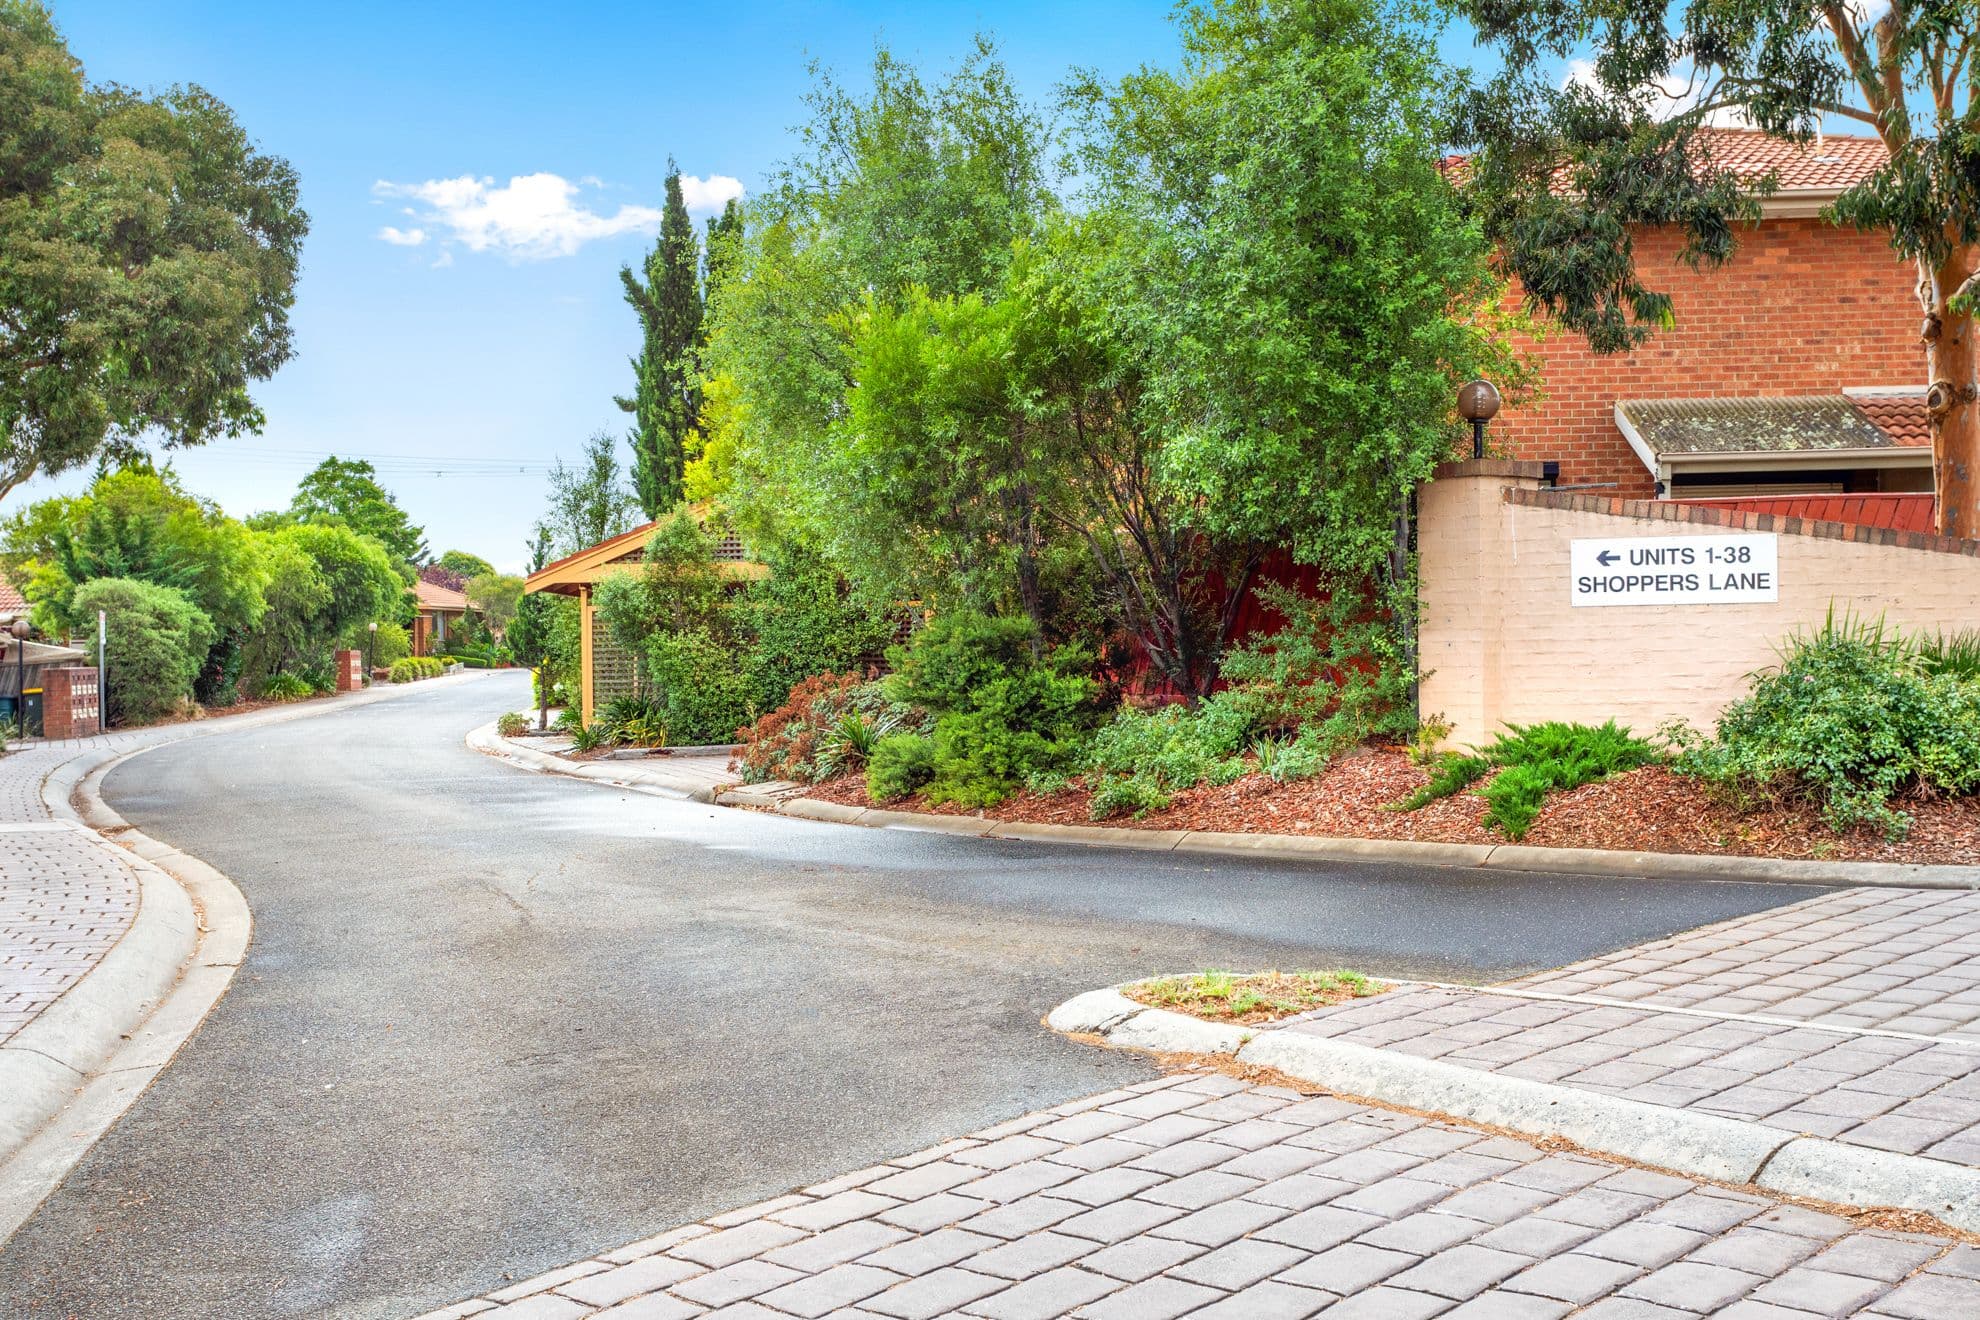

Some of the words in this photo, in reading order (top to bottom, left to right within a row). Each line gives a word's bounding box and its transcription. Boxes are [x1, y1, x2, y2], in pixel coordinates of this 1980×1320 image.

[1630, 547, 1695, 566] UNITS
[1705, 546, 1751, 564] 1-38
[1578, 574, 1699, 593] SHOPPERS
[1709, 572, 1771, 590] LANE
